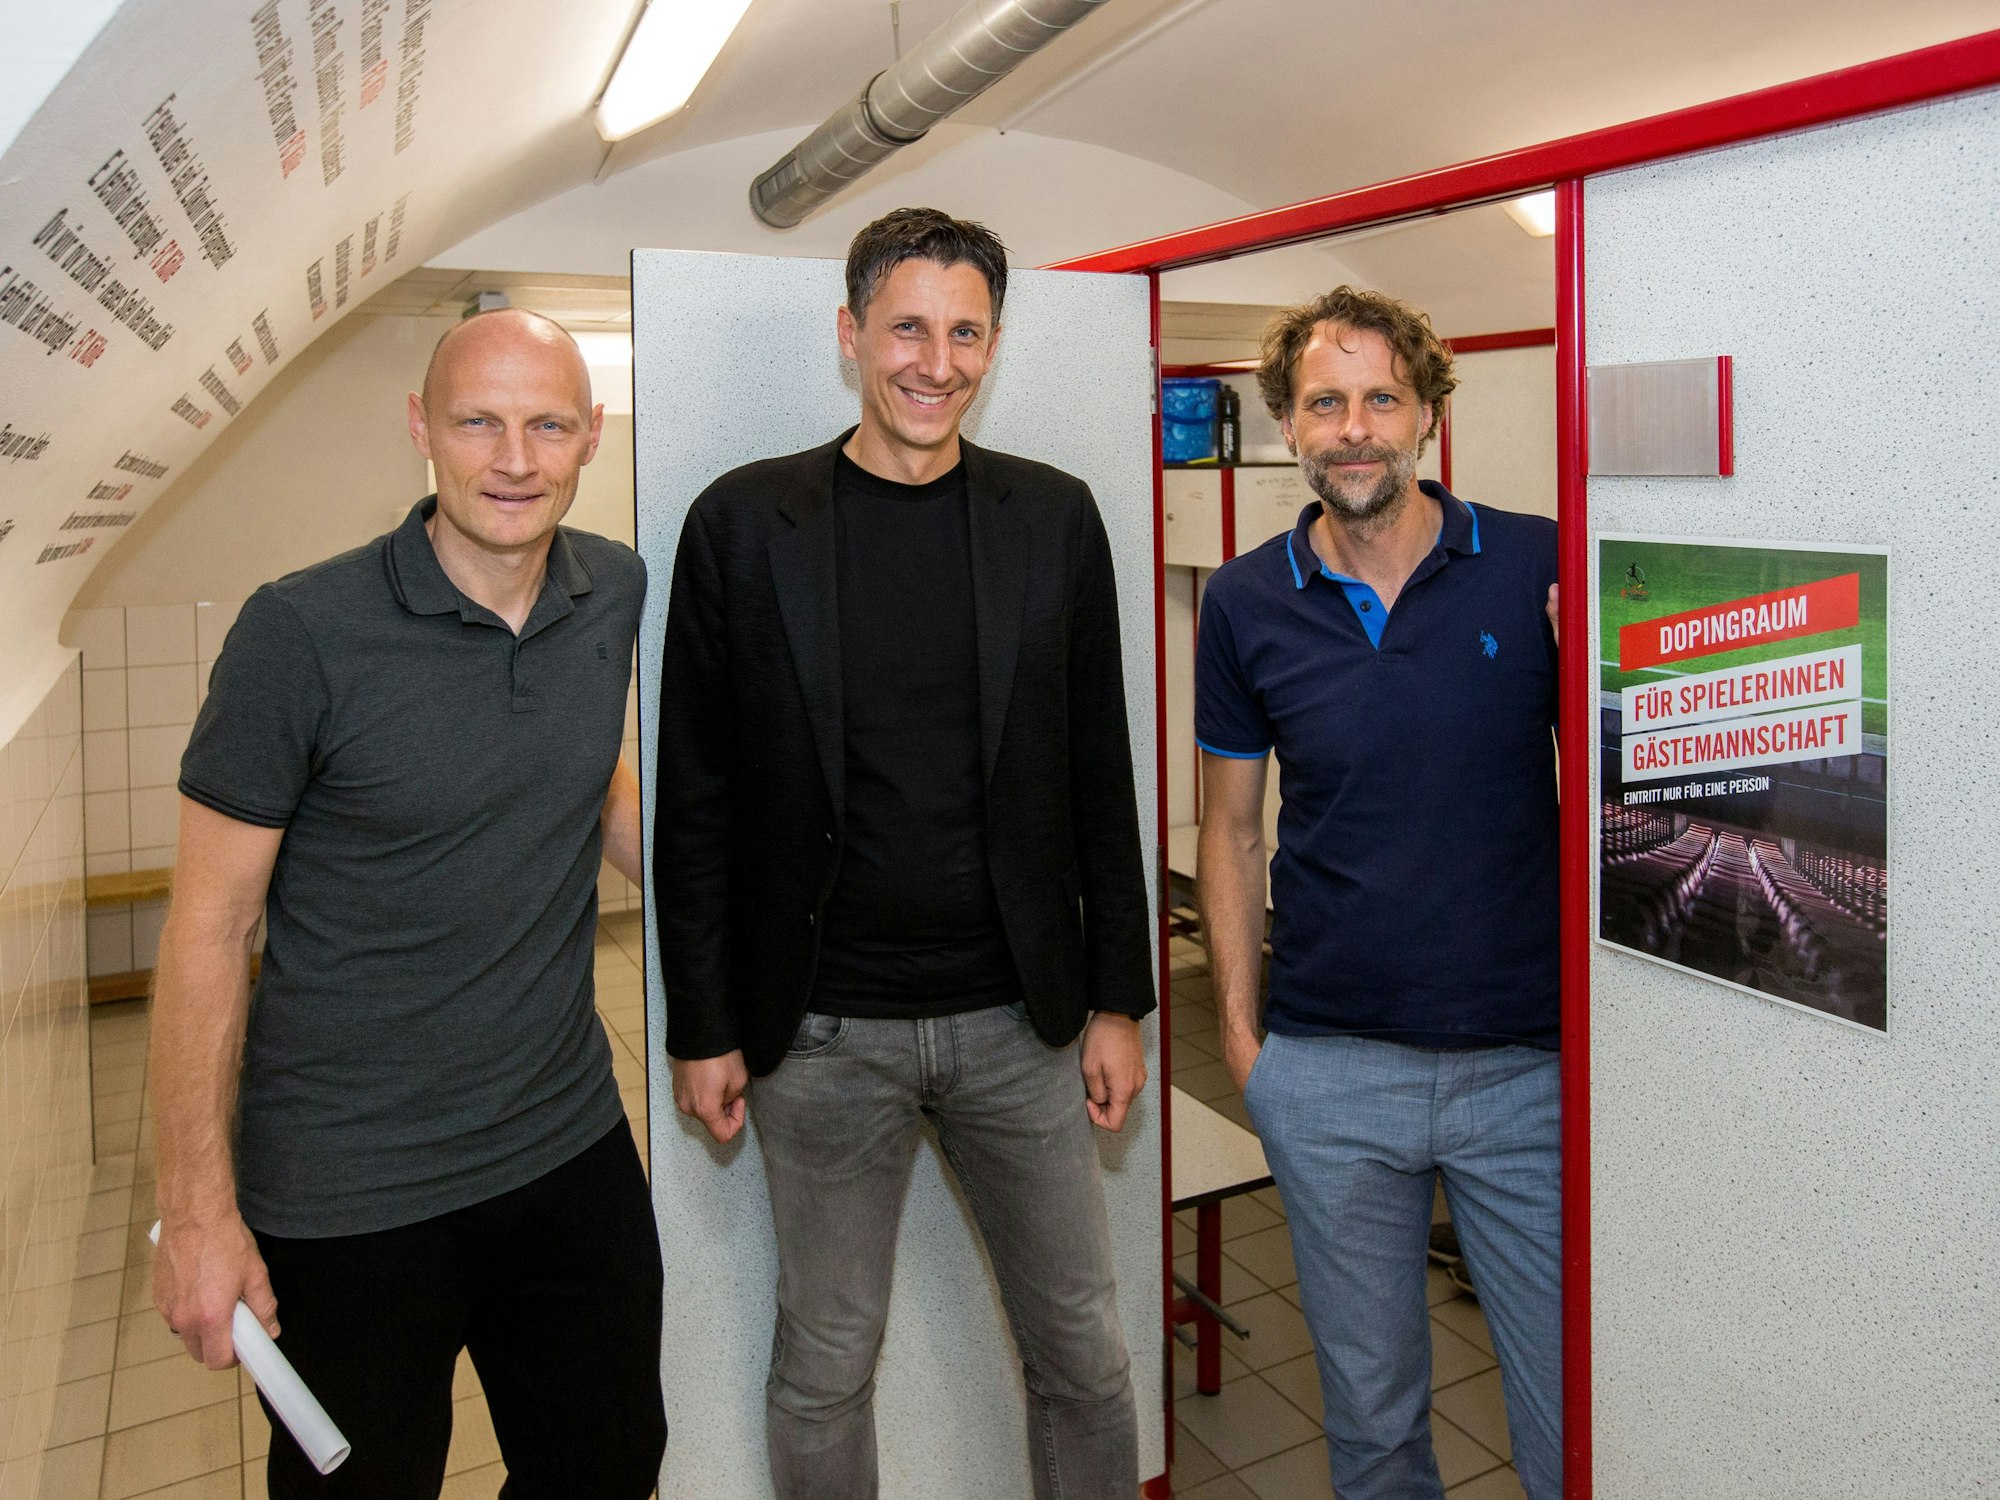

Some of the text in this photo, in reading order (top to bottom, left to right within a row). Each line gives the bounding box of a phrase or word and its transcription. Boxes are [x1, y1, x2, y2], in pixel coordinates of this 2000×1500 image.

[311, 6, 336, 36] en
[360, 4, 390, 49] Fans
[398, 9, 431, 65] Nippes,
[310, 18, 344, 72] Rom,
[254, 49, 293, 88] jitt
[361, 59, 388, 87] FC
[265, 75, 295, 101] et
[267, 81, 298, 125] Fans
[142, 92, 187, 154] Freud
[159, 137, 193, 176] oder
[279, 129, 306, 159] FC
[87, 149, 124, 187] E
[93, 160, 142, 214] Jeföhl
[171, 153, 204, 201] Leid,
[33, 208, 69, 249] Ov
[115, 191, 150, 230] dat
[193, 209, 215, 232] un
[46, 225, 84, 263] vür
[126, 211, 168, 260] verbingk
[149, 239, 178, 270] FC
[60, 244, 89, 272] ov
[70, 252, 116, 294] zoröck
[156, 249, 185, 284] Kölle
[96, 279, 129, 312] neues
[111, 288, 146, 323] Spell
[18, 296, 53, 334] dat
[33, 312, 82, 356] verbingk
[126, 301, 155, 332] heiß
[136, 316, 162, 343] neues
[67, 329, 97, 359] FC
[77, 335, 108, 368] Kölle
[1660, 595, 1807, 655] DOPINGRAUM
[1635, 658, 1845, 722] FÜR SPIELERINNEN
[1633, 714, 1848, 771] GÄSTEMANNSCHAFT
[1624, 776, 1769, 805] EINTRITT NUR FÜR EINE PERSON
